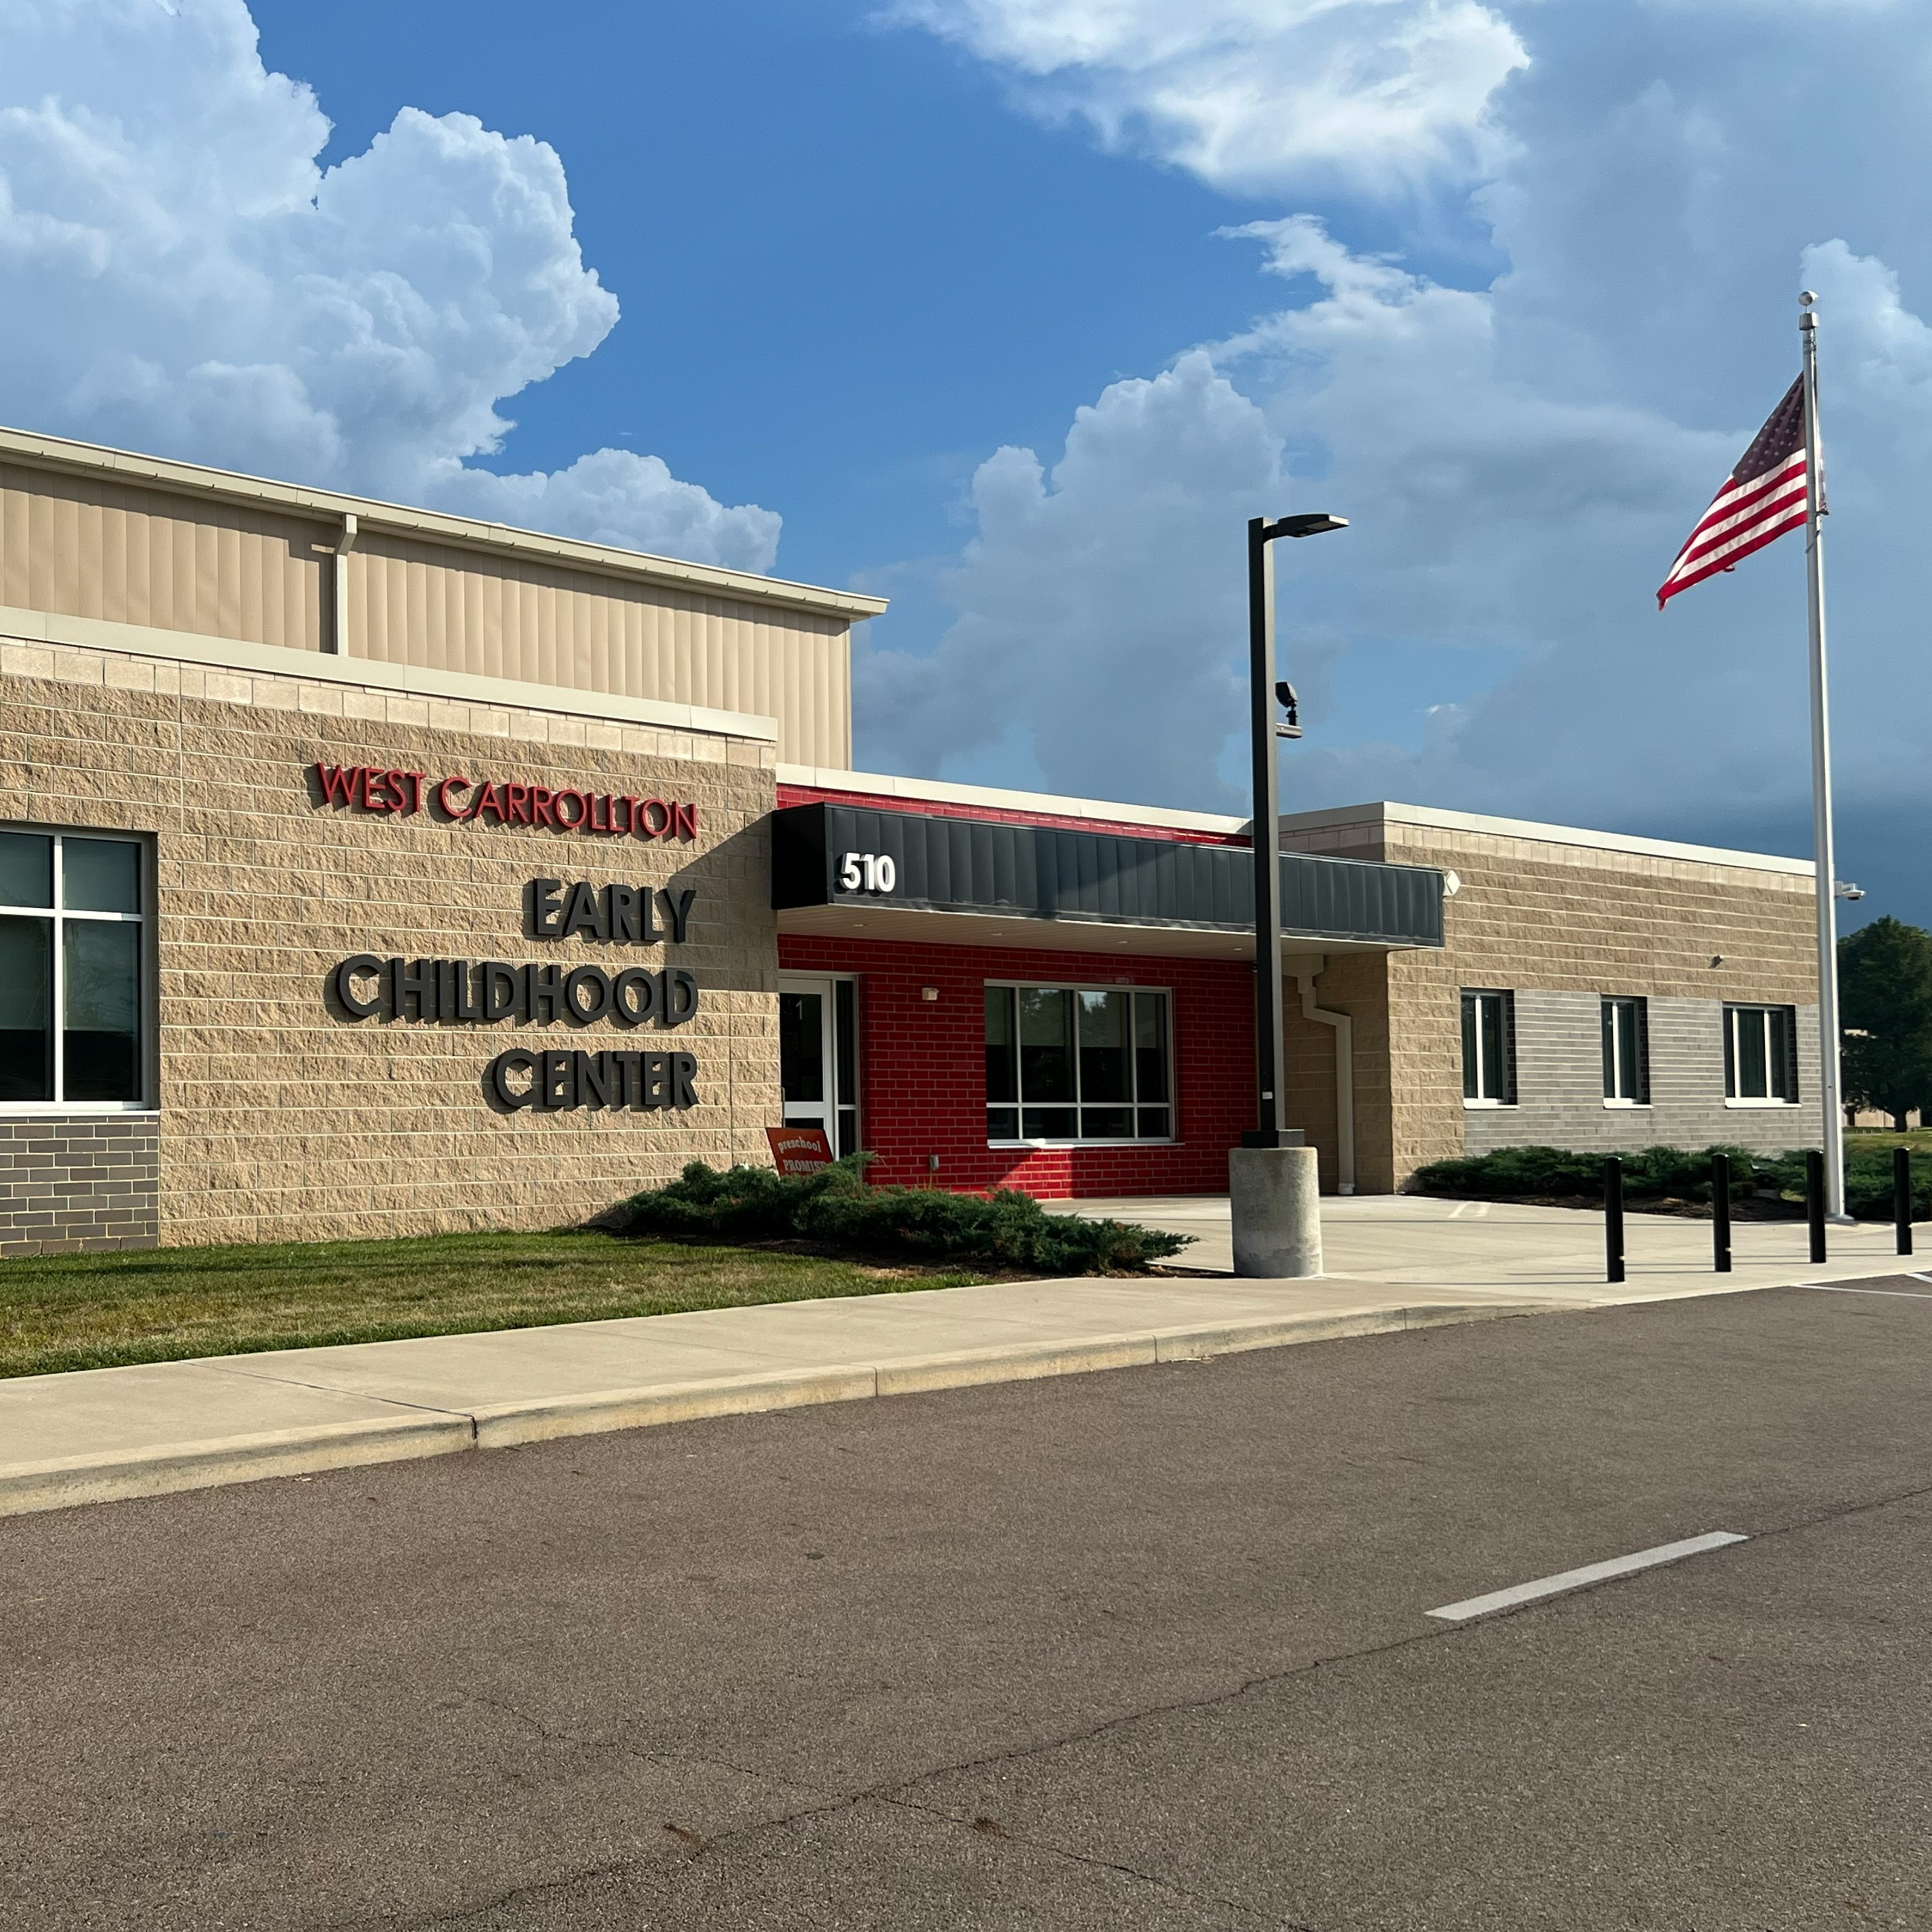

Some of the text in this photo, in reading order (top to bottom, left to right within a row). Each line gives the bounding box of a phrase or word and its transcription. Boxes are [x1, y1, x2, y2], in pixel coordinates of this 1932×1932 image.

[316, 762, 697, 839] WEST CARROLLTON
[839, 852, 895, 892] 510
[532, 877, 697, 944] EARLY
[336, 954, 699, 1025] CHILDHOOD
[493, 1048, 699, 1108] CENTER
[777, 1136, 822, 1153] preschool
